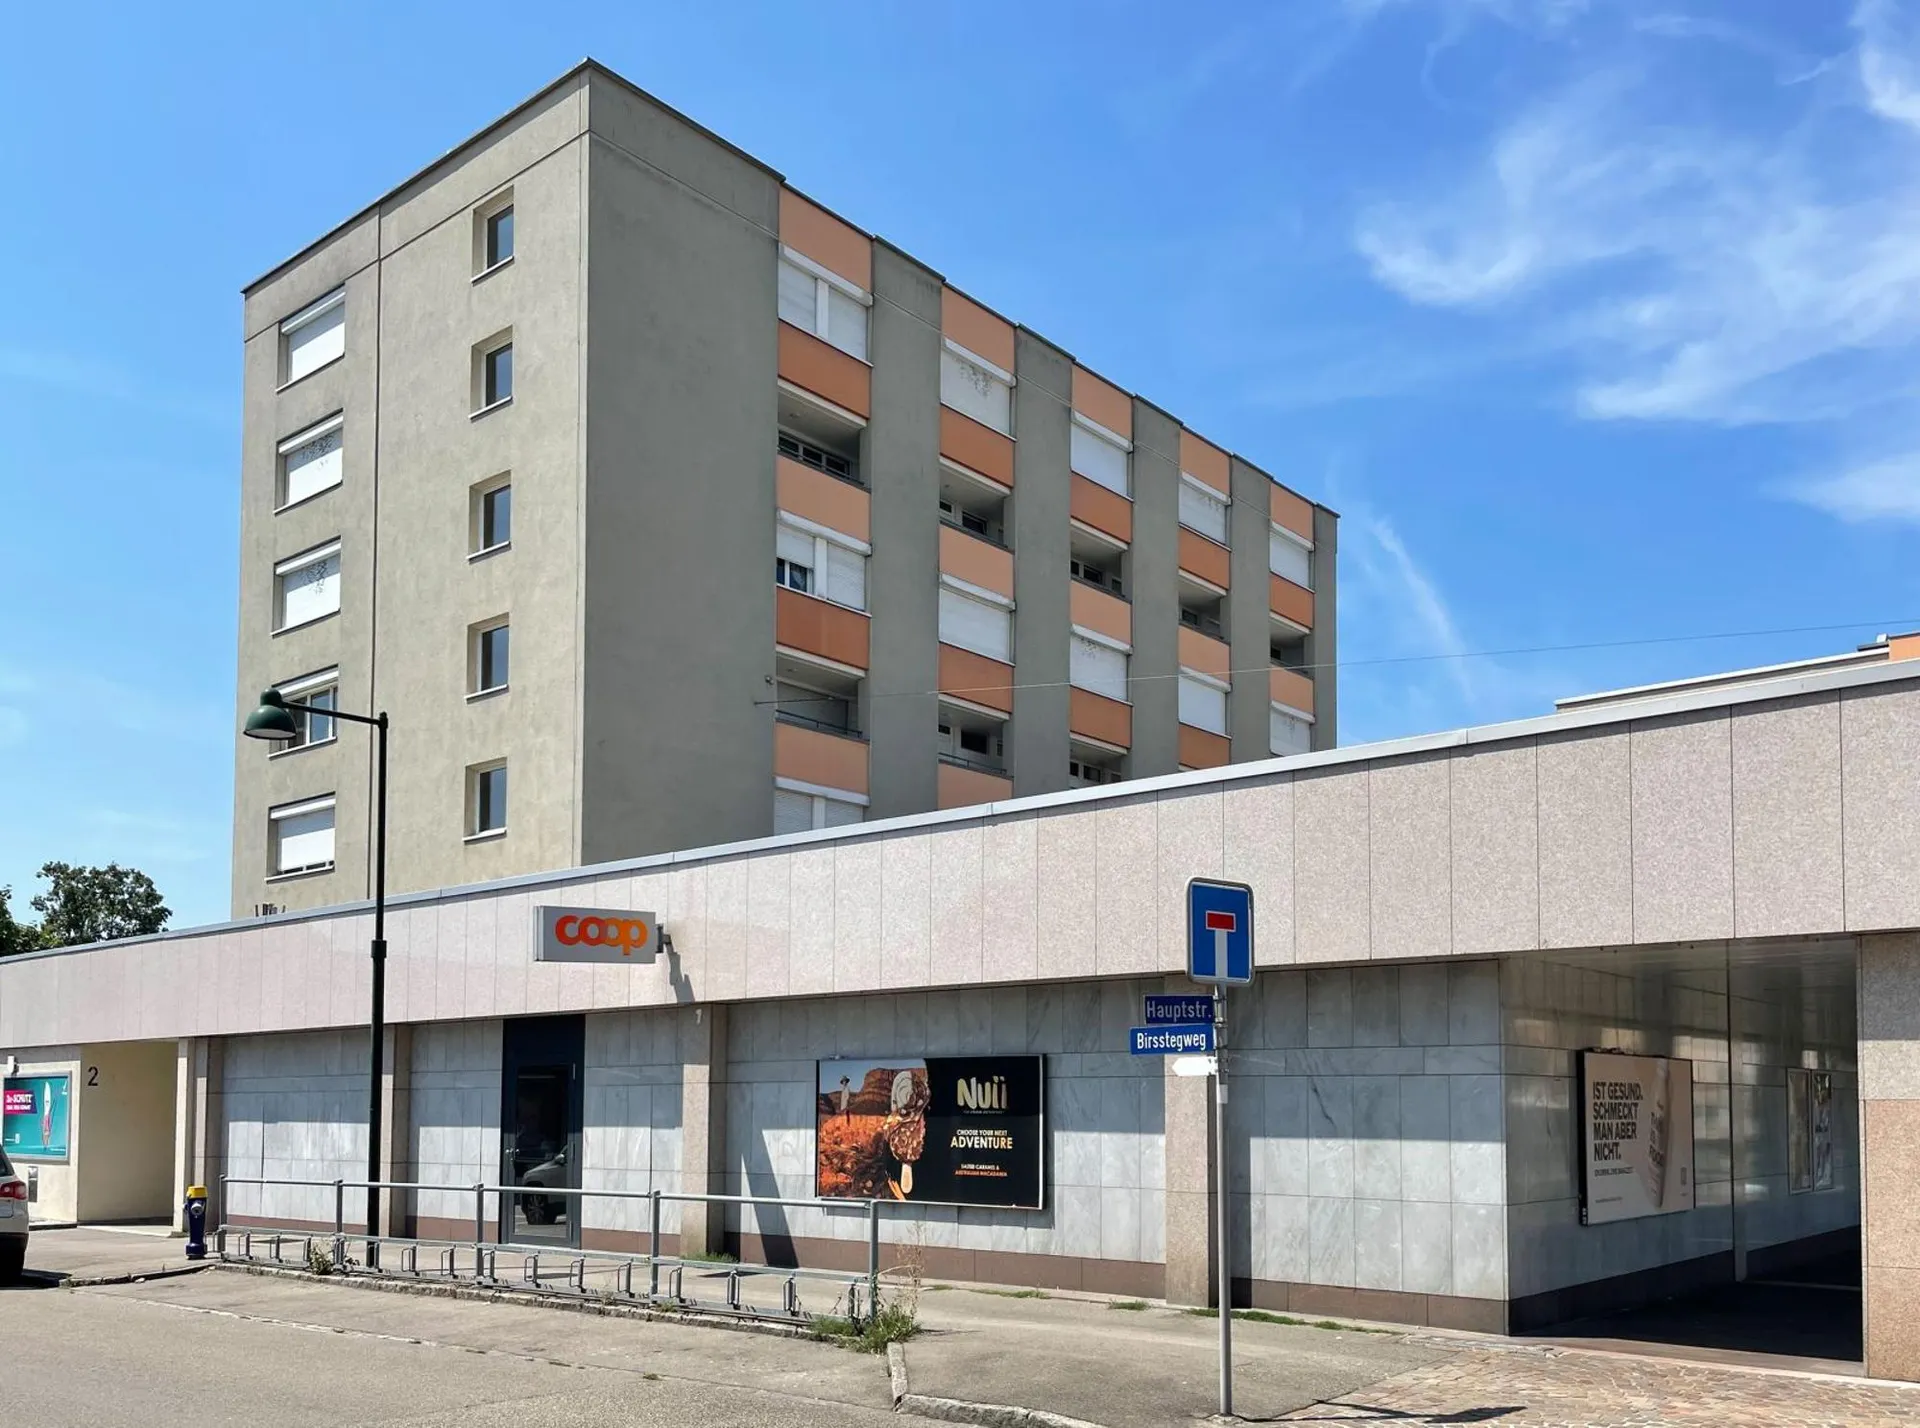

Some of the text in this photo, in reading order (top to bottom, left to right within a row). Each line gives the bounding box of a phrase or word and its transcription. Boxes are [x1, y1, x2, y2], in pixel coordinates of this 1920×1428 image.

[555, 914, 648, 956] coop
[1146, 1000, 1212, 1021] Hauptstr.
[1136, 1032, 1206, 1051] Birsstegweg
[87, 1066, 99, 1086] 2
[957, 1075, 1008, 1110] Nuii
[1593, 1082, 1643, 1101] IST GESUND.
[1593, 1102, 1639, 1120] SCHMECKT
[1593, 1122, 1613, 1141] MAN
[1614, 1121, 1637, 1140] ABER
[950, 1136, 1013, 1149] ADVENTURE
[1594, 1142, 1622, 1162] NICHT.
